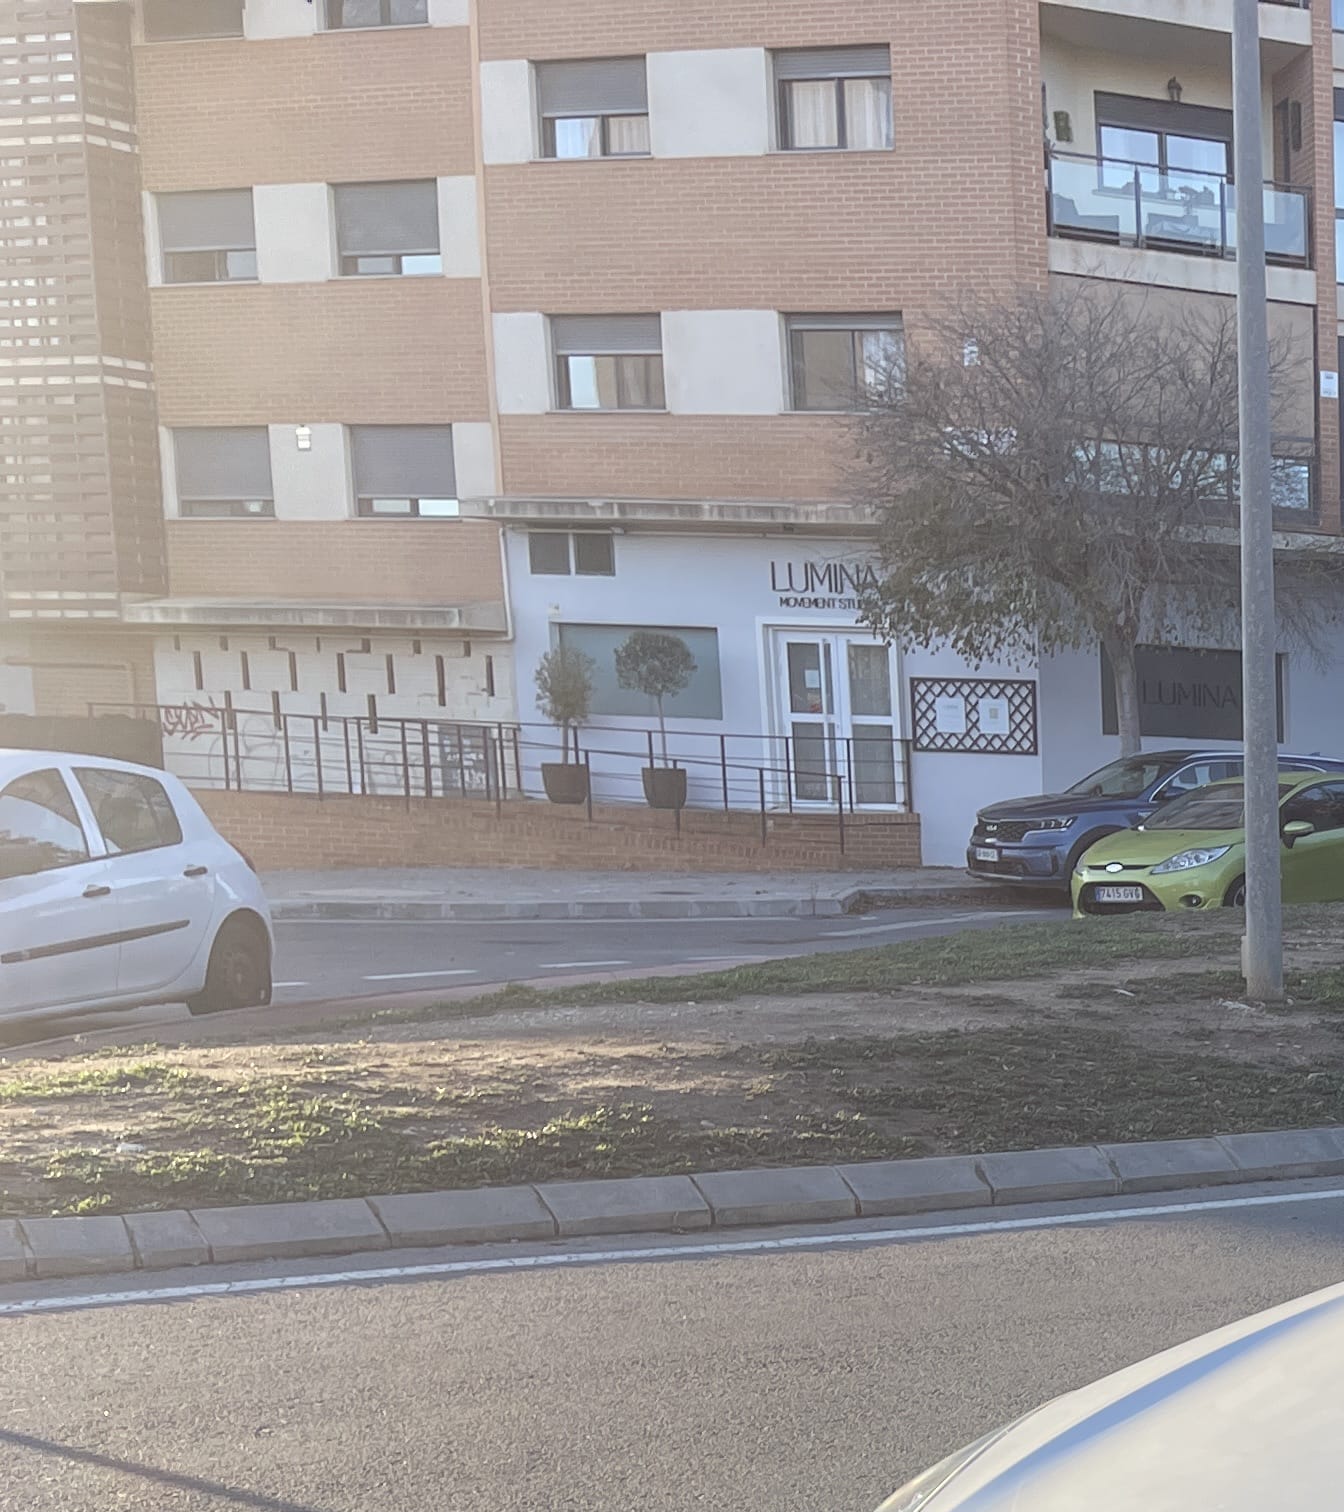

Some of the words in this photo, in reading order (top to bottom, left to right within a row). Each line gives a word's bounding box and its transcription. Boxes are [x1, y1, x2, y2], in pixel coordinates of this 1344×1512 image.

[771, 561, 881, 594] LUMINA
[779, 597, 836, 609] MOVEMENT
[1142, 679, 1239, 708] LUMINA
